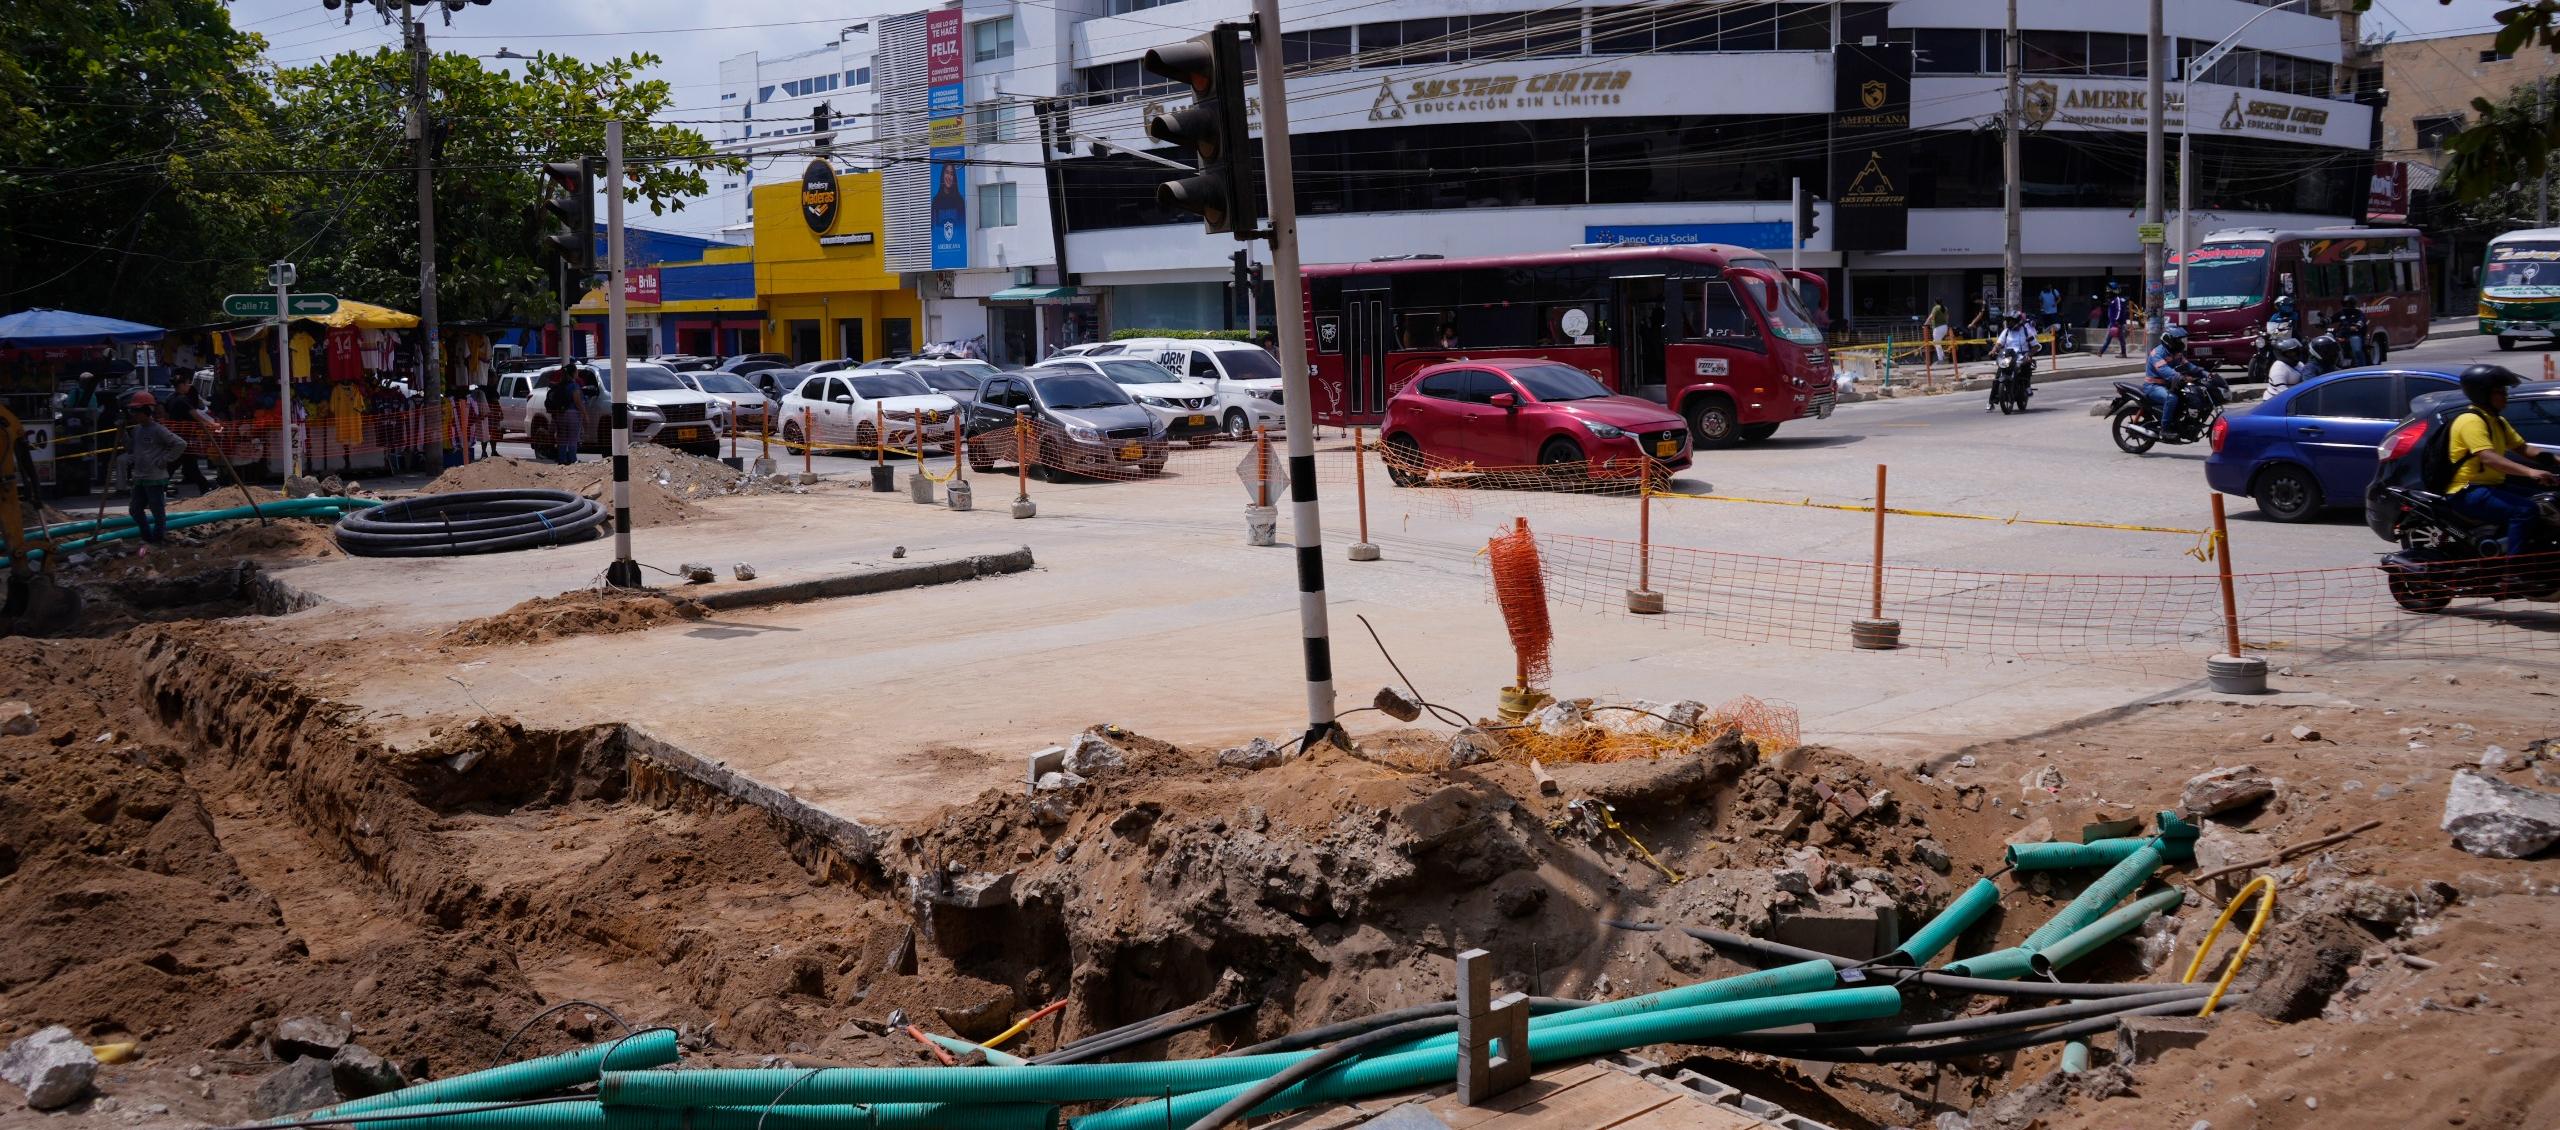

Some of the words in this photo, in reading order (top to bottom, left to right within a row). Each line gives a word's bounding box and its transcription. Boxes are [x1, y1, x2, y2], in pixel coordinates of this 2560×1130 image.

[932, 30, 940, 38] TE
[941, 26, 957, 37] HACE
[931, 40, 959, 57] FELIZ,
[1407, 76, 1519, 99] SYSTEM
[1526, 71, 1632, 93] CENTER
[1415, 96, 1508, 114] EDUCACIÓN
[1517, 97, 1543, 108] SIN
[1553, 92, 1621, 106] LÍMITES
[1840, 115, 1907, 125] AMERICANA
[802, 190, 835, 205] Maderas
[1618, 235, 1647, 243] Banco
[1649, 234, 1669, 244] Caja
[1670, 233, 1698, 243] Social
[638, 274, 657, 288] Brilla
[235, 301, 257, 310] Calle
[259, 301, 270, 310] 72
[336, 335, 352, 354] 14
